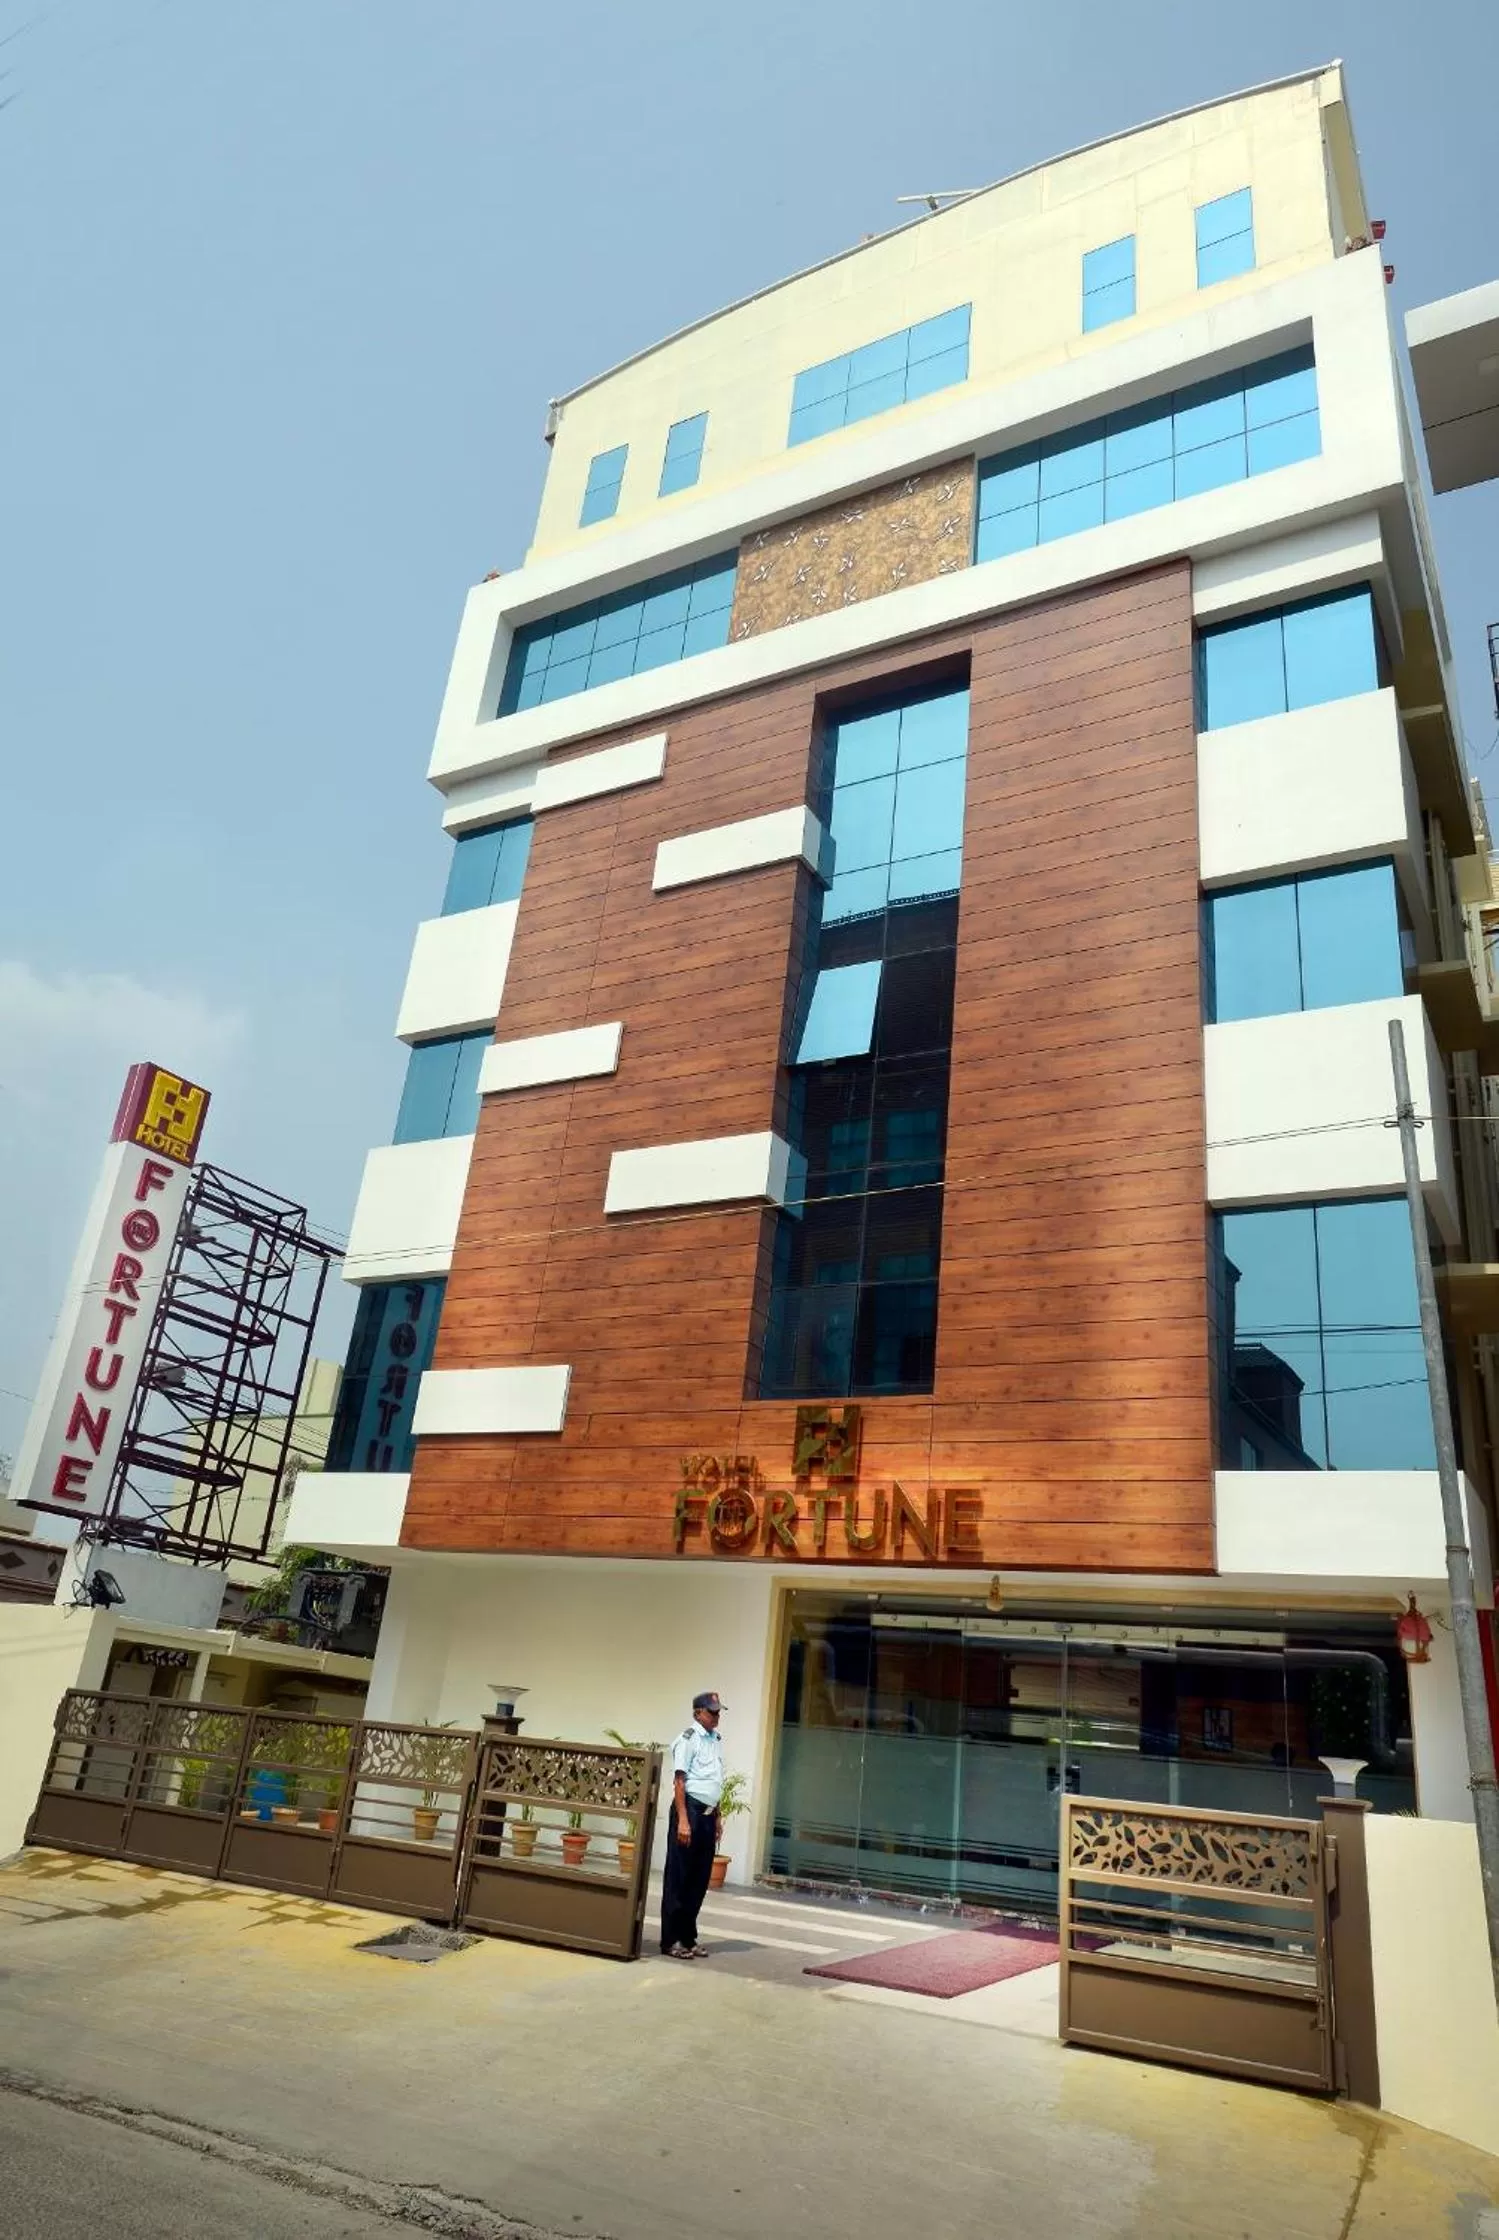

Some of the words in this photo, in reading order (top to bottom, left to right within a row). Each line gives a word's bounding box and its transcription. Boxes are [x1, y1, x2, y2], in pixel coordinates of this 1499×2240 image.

[136, 1123, 191, 1162] HOTEL
[52, 1158, 174, 1503] FORTUNE
[680, 1455, 759, 1477] HOTEL
[674, 1480, 982, 1555] FORTUNE
